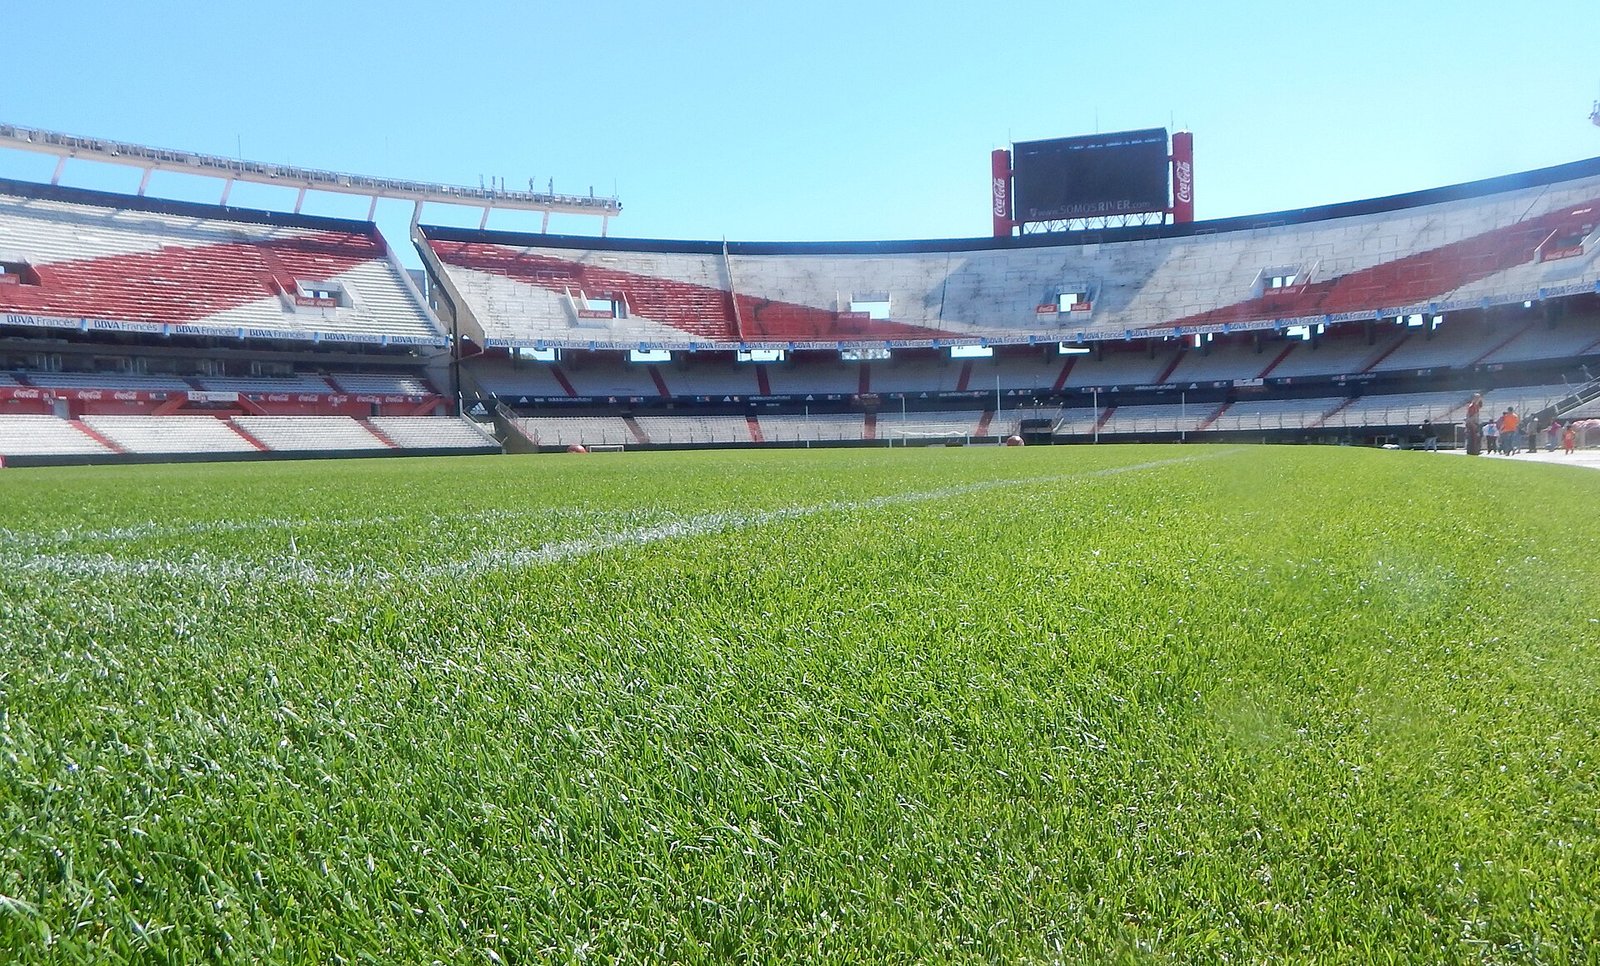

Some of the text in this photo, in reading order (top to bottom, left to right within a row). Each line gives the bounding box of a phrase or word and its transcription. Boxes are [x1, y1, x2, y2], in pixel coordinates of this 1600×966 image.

[6, 314, 34, 325] BBVA
[94, 320, 120, 330] BBVA
[175, 325, 200, 335] BBVA
[249, 329, 273, 338] BBVA
[324, 333, 346, 341] BBVA
